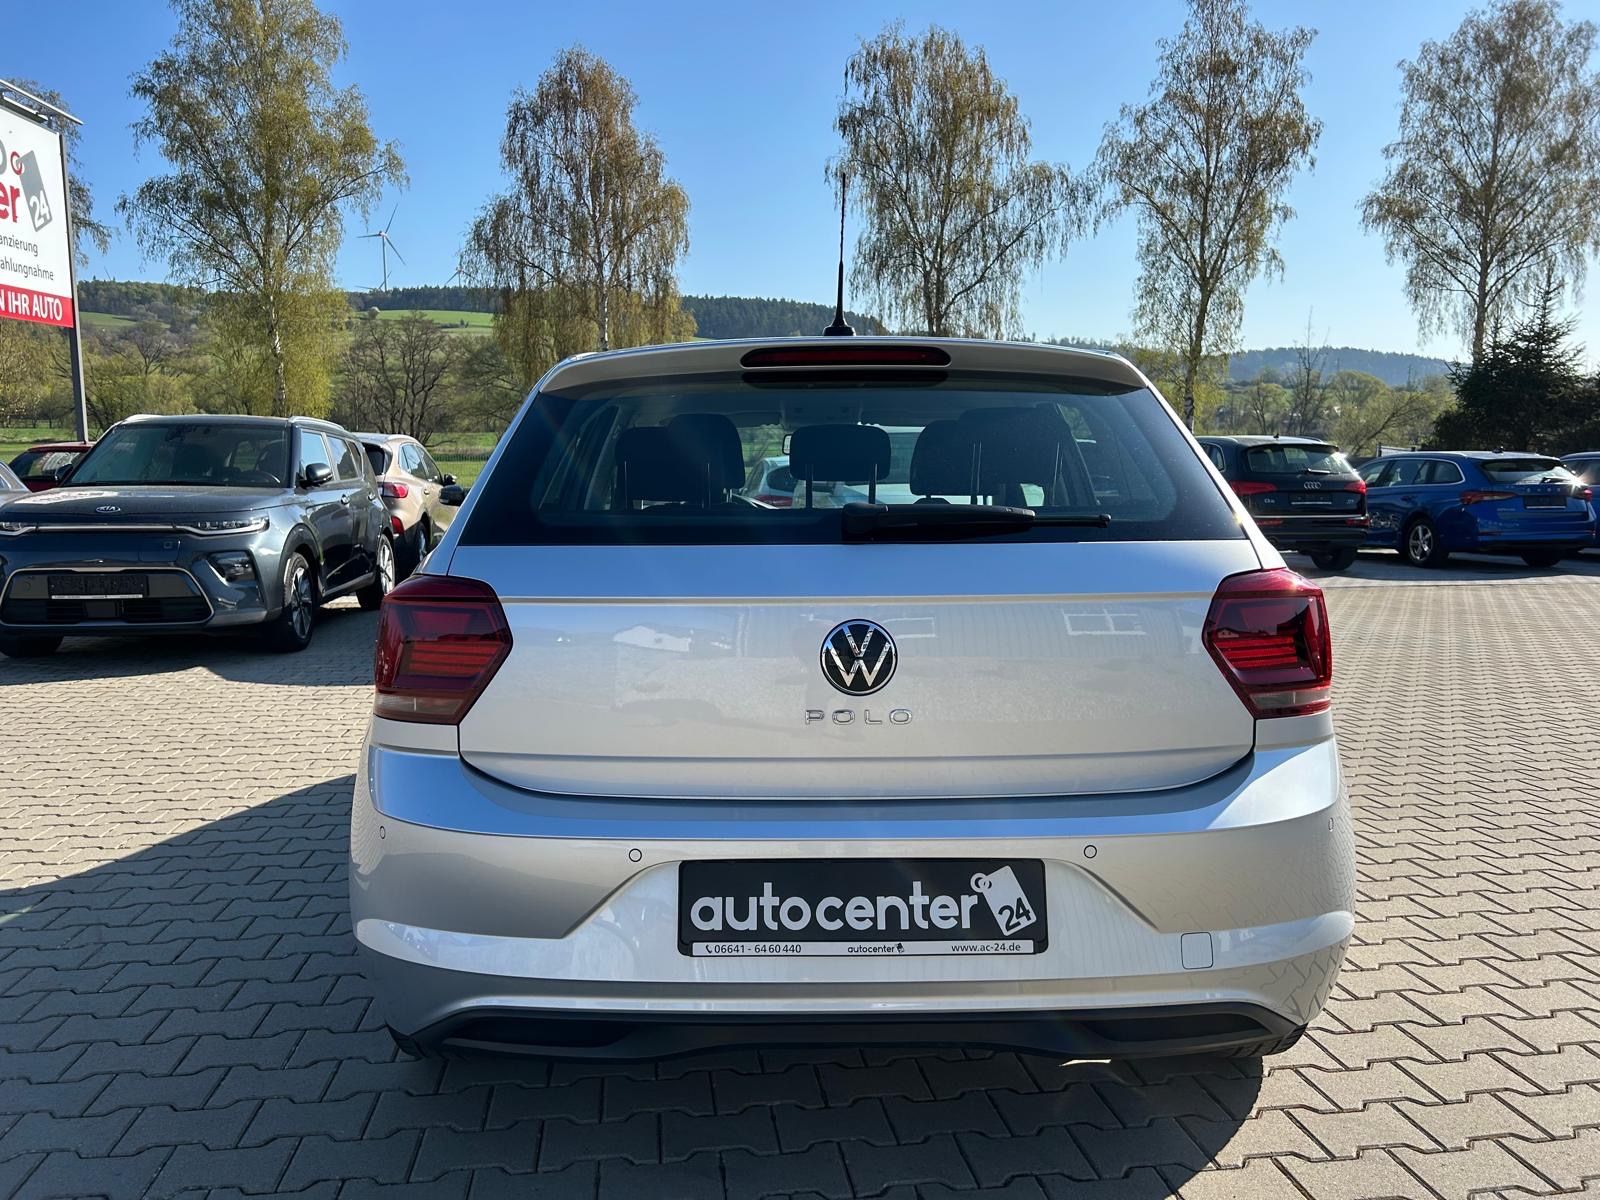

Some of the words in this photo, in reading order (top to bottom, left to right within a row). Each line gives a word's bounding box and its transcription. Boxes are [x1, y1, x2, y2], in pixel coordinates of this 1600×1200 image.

[29, 190, 50, 229] 24
[0, 256, 54, 281] ahlungnahme
[8, 291, 30, 316] IHR
[32, 295, 62, 320] AUTO
[805, 708, 913, 726] POLO
[690, 881, 978, 931] autocenter
[997, 896, 1032, 932] 24
[714, 944, 745, 954] 06641
[847, 944, 895, 954] autocenter
[951, 942, 1022, 953] www.ac-24.de
